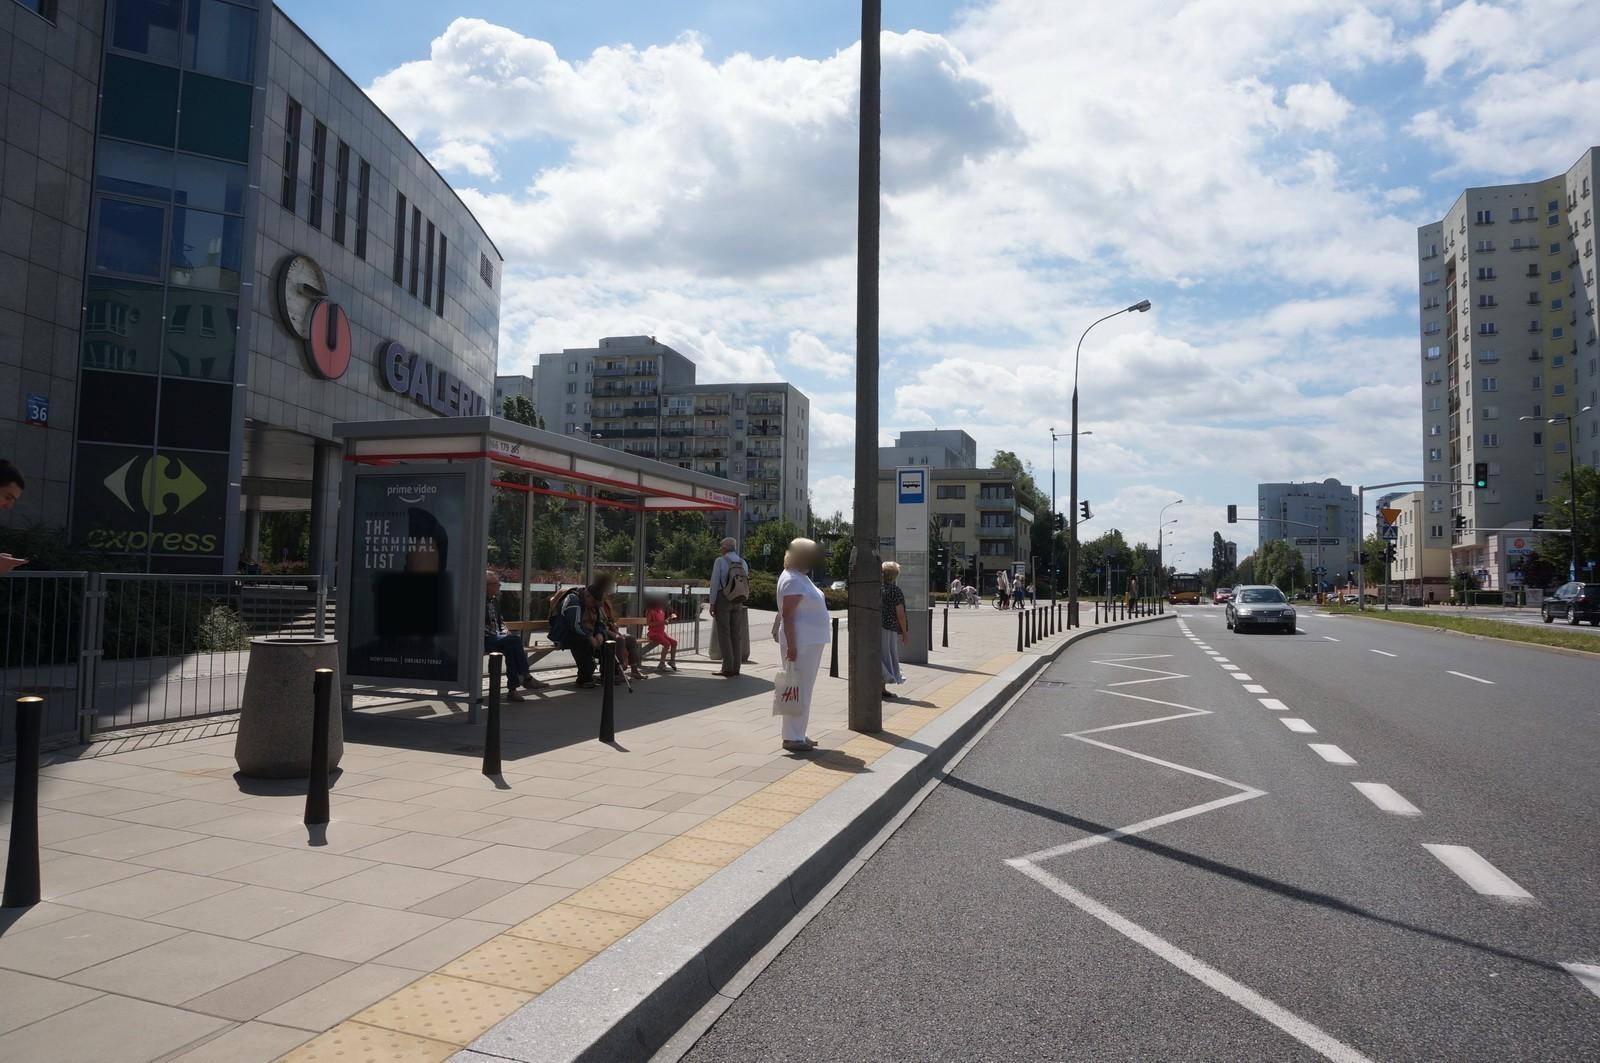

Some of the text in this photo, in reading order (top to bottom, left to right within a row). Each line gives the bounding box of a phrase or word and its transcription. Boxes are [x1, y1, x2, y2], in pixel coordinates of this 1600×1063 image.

[31, 405, 47, 421] 36
[387, 484, 437, 495] prime video
[365, 519, 390, 535] THE
[87, 529, 217, 552] express
[365, 536, 435, 552] TERMINAL
[365, 553, 395, 569] LIST
